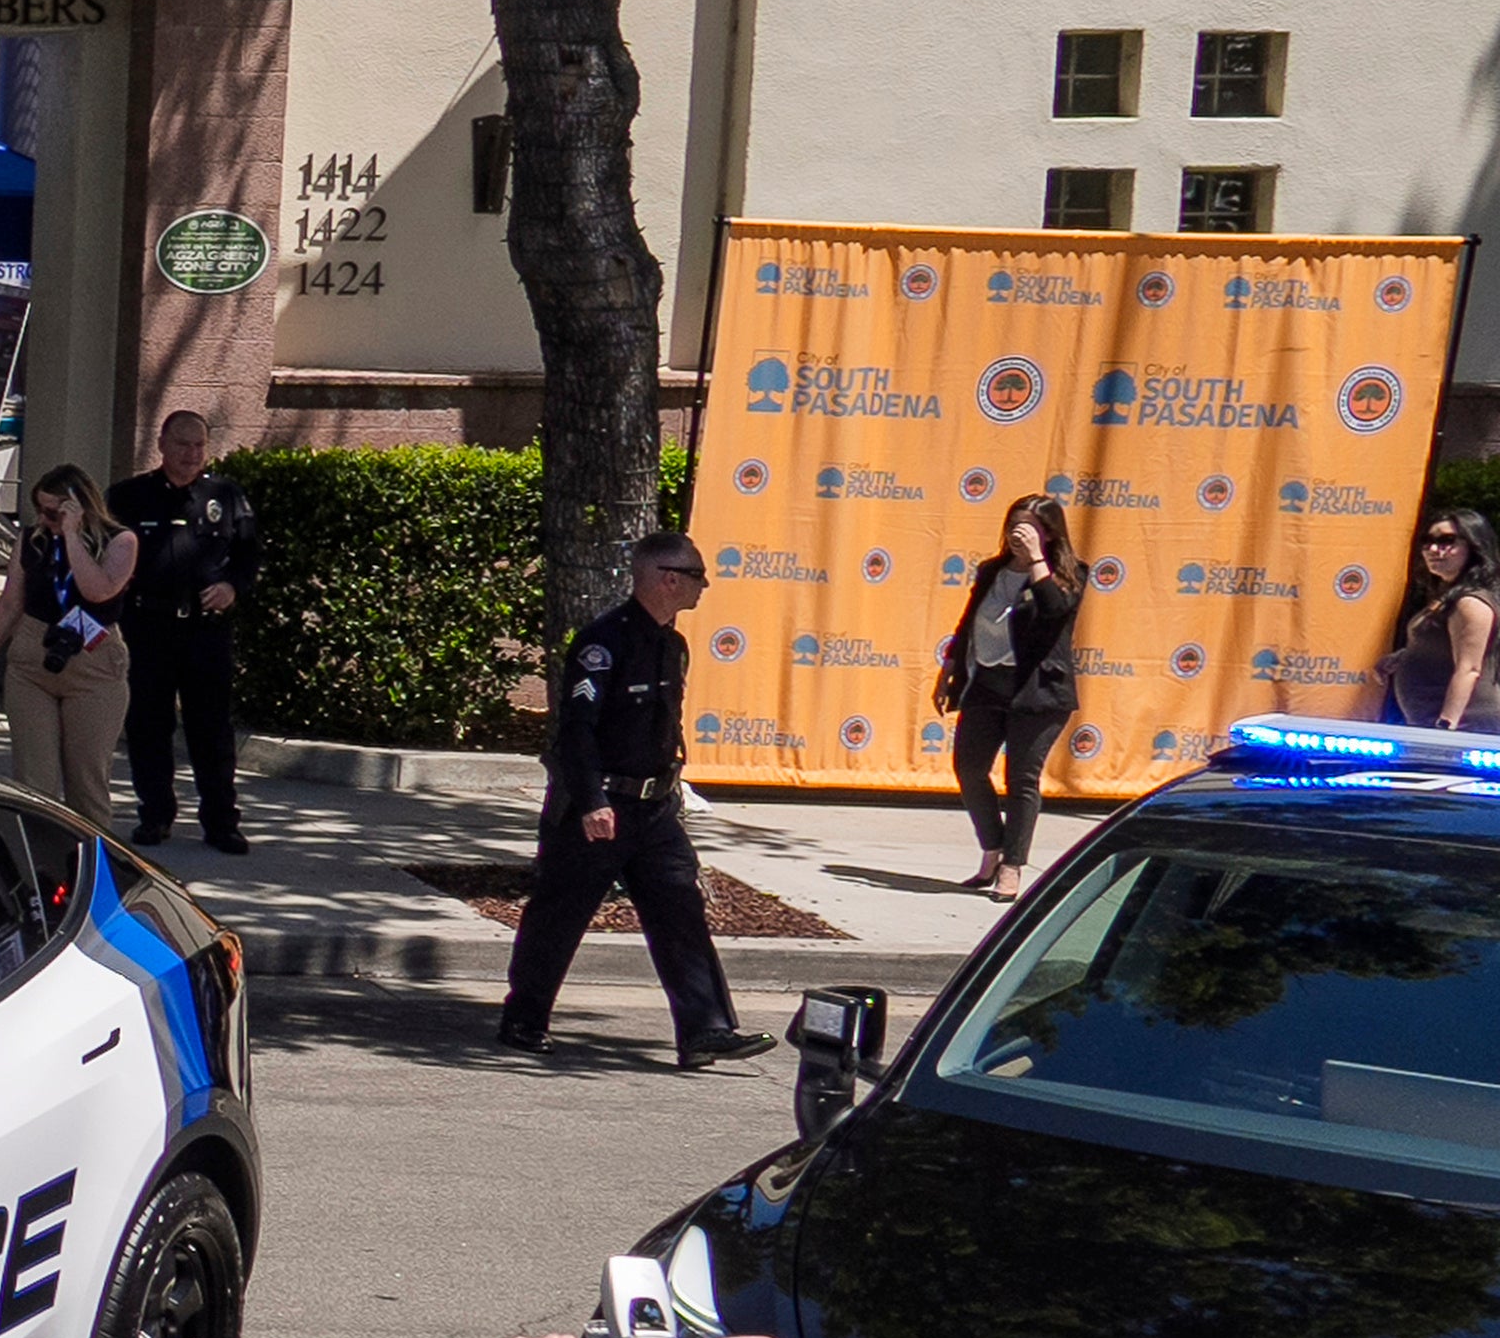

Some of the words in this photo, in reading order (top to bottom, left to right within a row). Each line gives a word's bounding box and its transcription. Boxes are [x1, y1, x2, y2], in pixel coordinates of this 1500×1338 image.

[298, 153, 381, 198] 1414
[296, 206, 388, 250] 1422
[165, 251, 206, 261] AGZA
[207, 250, 259, 262] GREEN
[172, 261, 215, 271] ZONE
[217, 261, 251, 272] CITY
[785, 266, 839, 283] SOUTH
[297, 261, 385, 295] 1424
[1016, 275, 1072, 292] SOUTH
[782, 280, 869, 299] PASADENA
[1254, 279, 1310, 295] SOUTH
[1013, 289, 1102, 306] PASADENA
[1250, 293, 1342, 312] PASADENA
[796, 352, 823, 368] City
[825, 352, 840, 366] of
[795, 366, 890, 392] SOUTH
[1144, 363, 1171, 379] City
[1172, 363, 1186, 376] of
[1141, 377, 1244, 404] SOUTH
[791, 391, 942, 420] PASADENA
[1137, 402, 1299, 429] PASADENA
[848, 469, 896, 486] SOUTH
[1077, 478, 1131, 494] SOUTH
[845, 484, 924, 501] PASADENA
[1073, 492, 1161, 510] PASADENA
[1312, 486, 1365, 501] SOUTH
[1308, 499, 1393, 516] PASADENA
[745, 551, 797, 565] SOUTH
[741, 565, 829, 584] PASADENA
[1208, 566, 1267, 581] SOUTH
[1205, 581, 1299, 599] PASADENA
[823, 639, 872, 653] SOUTH
[1073, 647, 1104, 662] UTH
[820, 653, 899, 668] PASADENA
[1073, 661, 1135, 677] SADENA
[1283, 656, 1340, 671] SOUTH
[1280, 669, 1367, 686] PASADENA
[724, 718, 775, 733] SOUTH
[721, 731, 806, 749] PASADENA
[1180, 733, 1231, 750] SOUT
